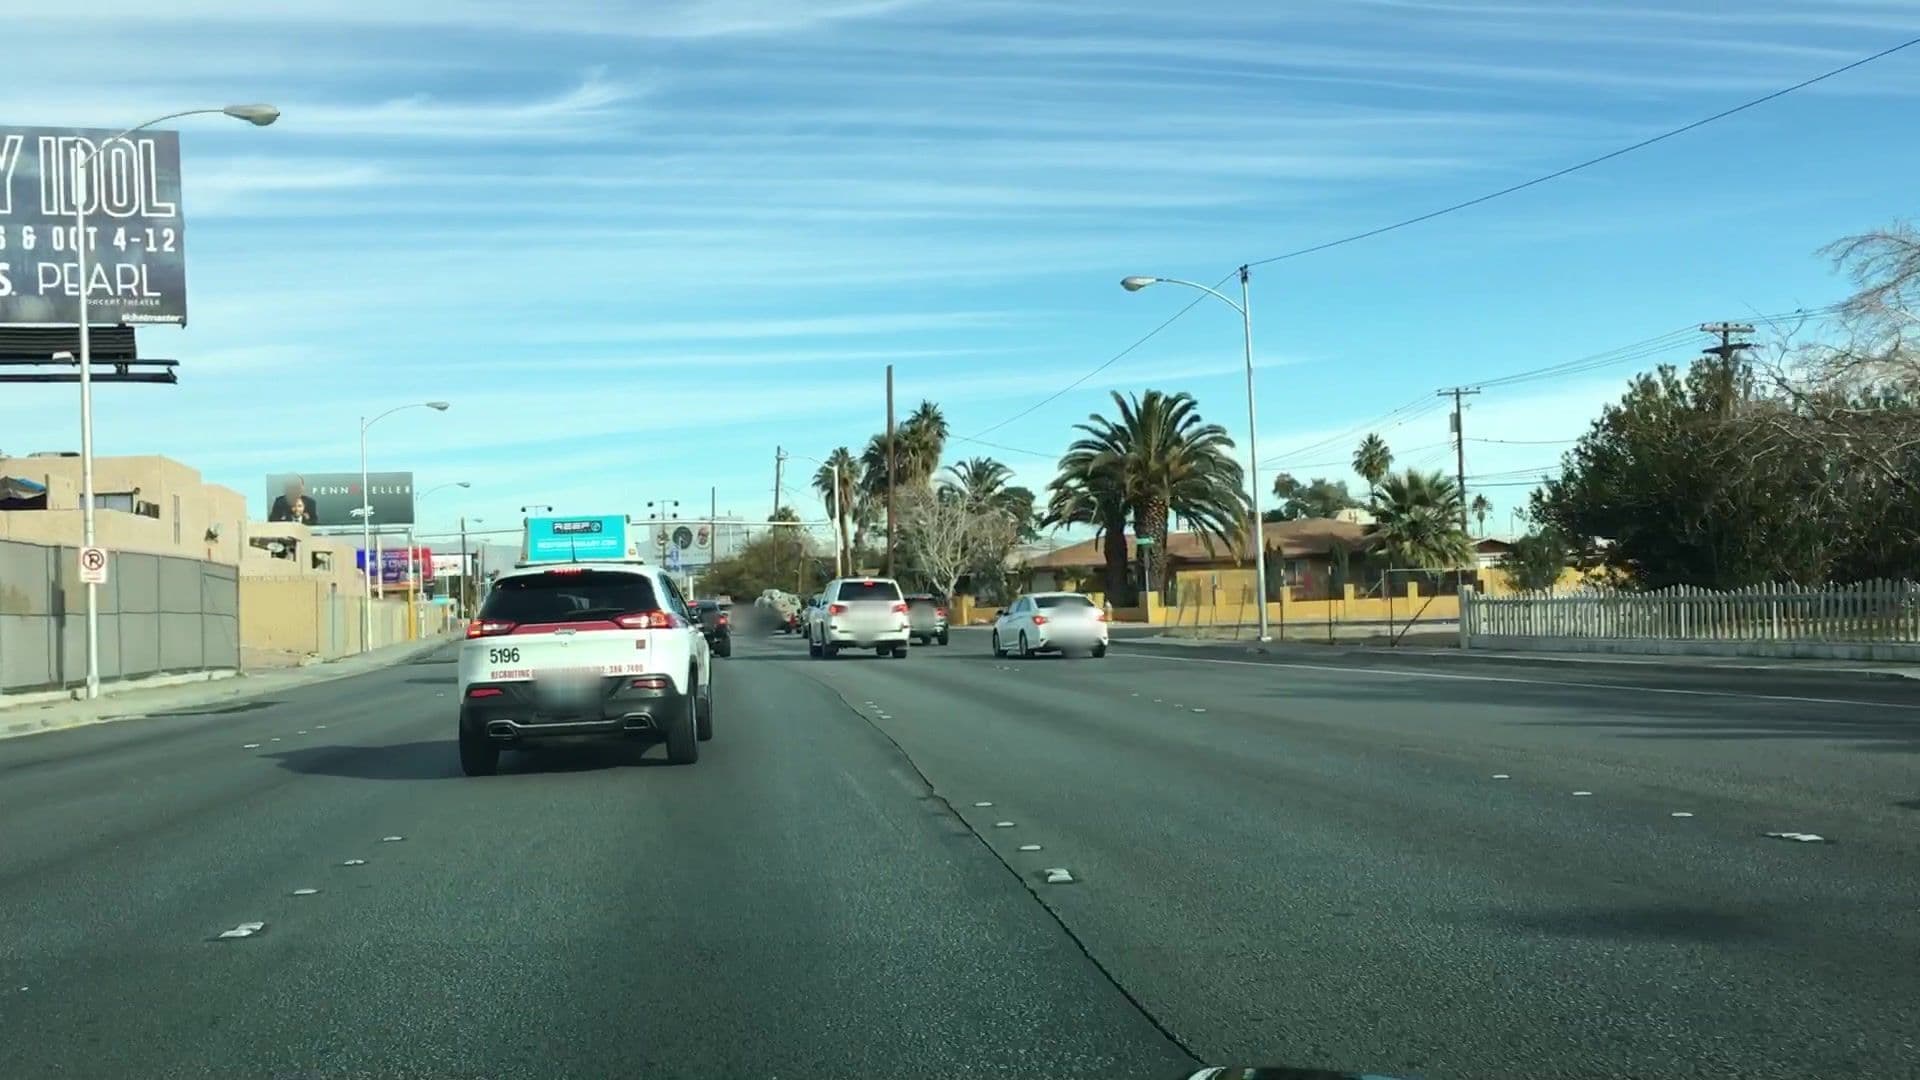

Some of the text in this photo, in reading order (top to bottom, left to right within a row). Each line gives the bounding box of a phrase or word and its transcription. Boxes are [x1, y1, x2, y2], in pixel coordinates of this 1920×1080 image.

[38, 135, 176, 218] IDOL
[22, 225, 37, 251] &
[52, 226, 98, 252] OCT
[113, 227, 176, 253] 4-12
[38, 262, 162, 297] PEARL
[489, 648, 520, 664] 5196
[490, 669, 530, 680] RECRUITING
